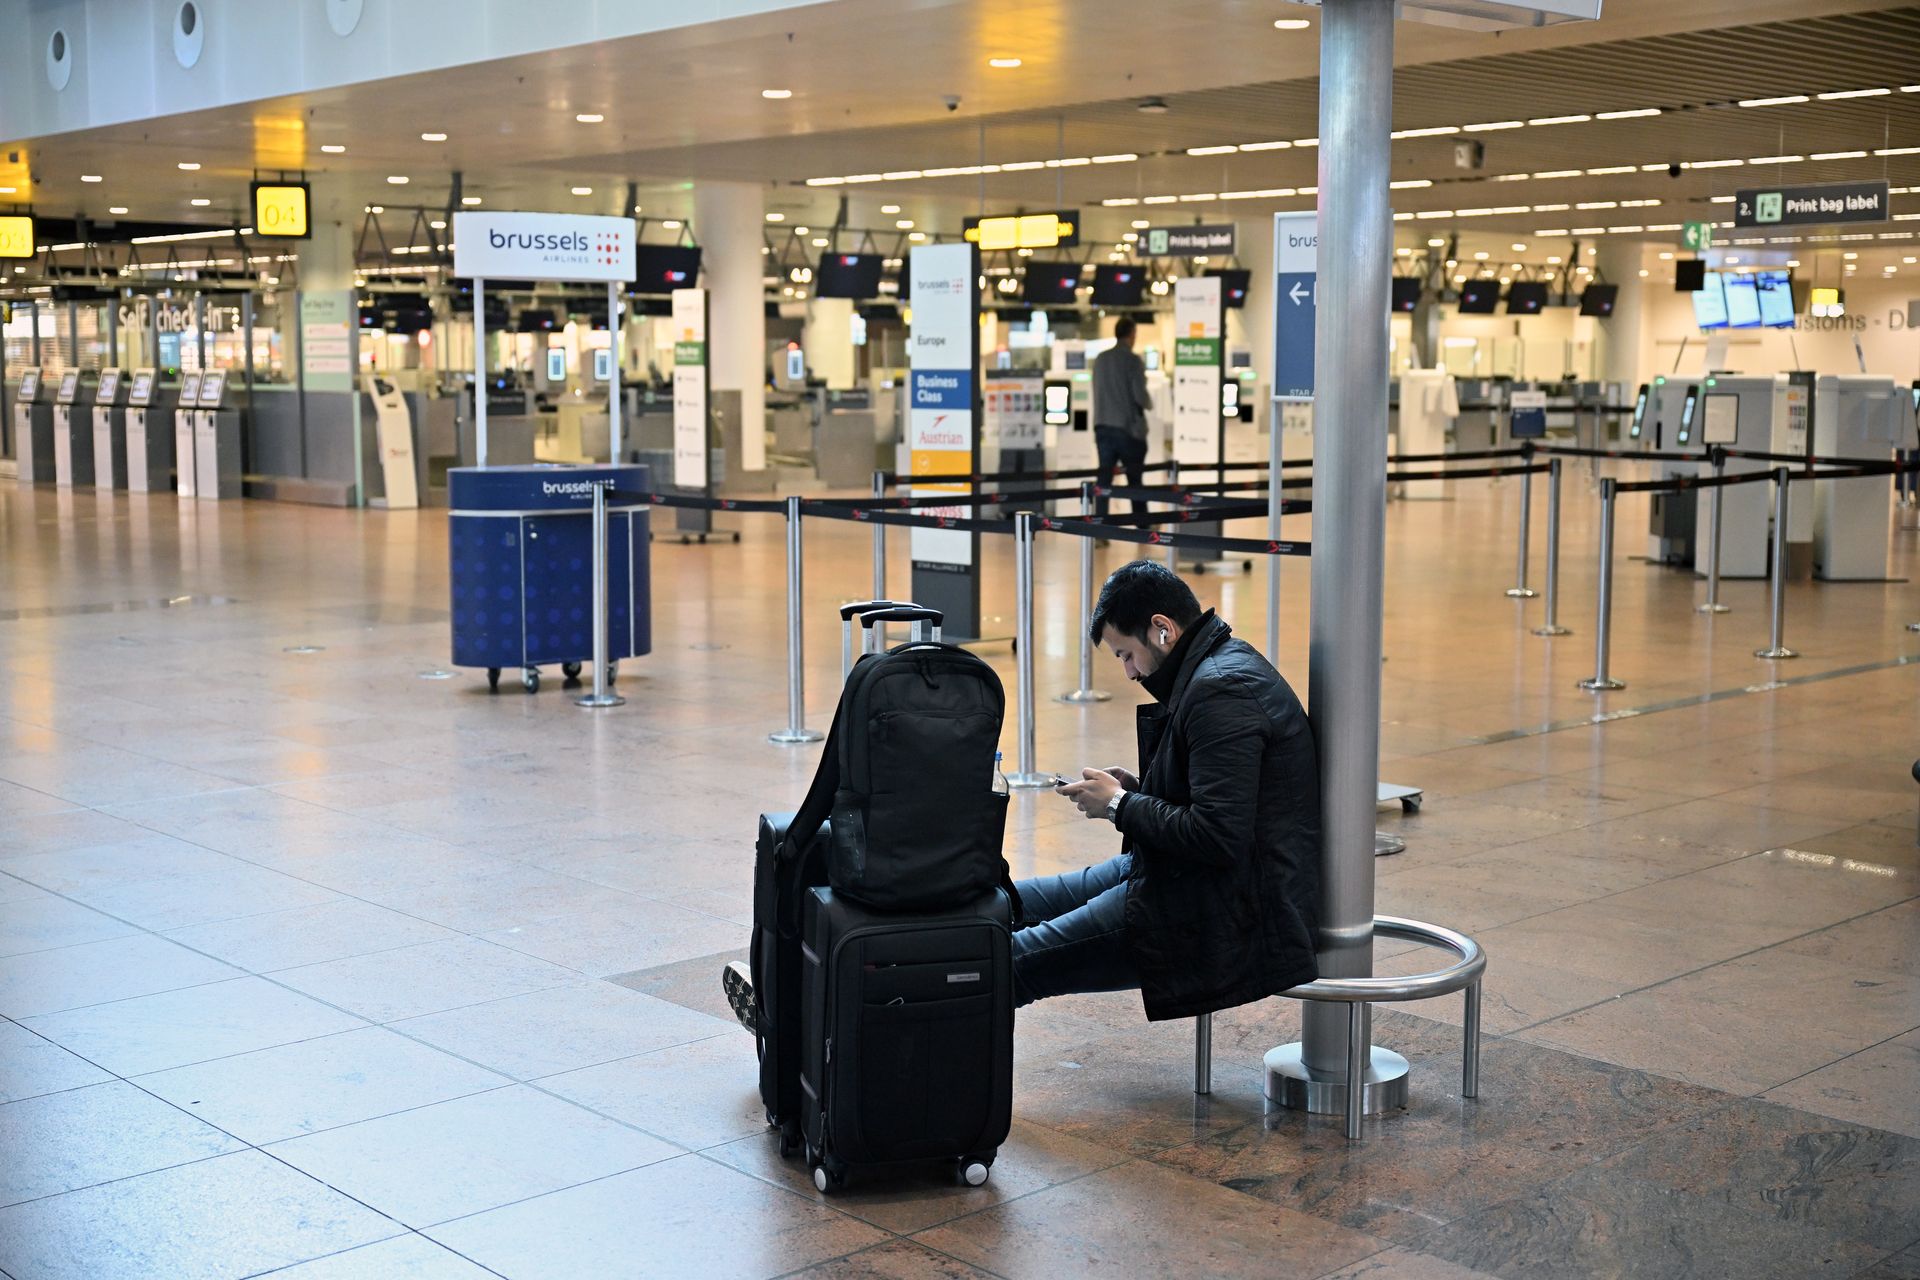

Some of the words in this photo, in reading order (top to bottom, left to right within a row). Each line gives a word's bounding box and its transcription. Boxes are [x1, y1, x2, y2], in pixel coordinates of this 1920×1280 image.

[1786, 198, 1818, 214] Print
[1820, 196, 1844, 214] bag
[1846, 193, 1879, 211] label
[264, 204, 297, 228] 04
[489, 227, 590, 251] brussels
[542, 254, 590, 265] AIRLINES
[917, 333, 946, 347] Europe
[917, 374, 958, 389] Business
[917, 388, 943, 403] Class
[919, 431, 963, 445] Austrian
